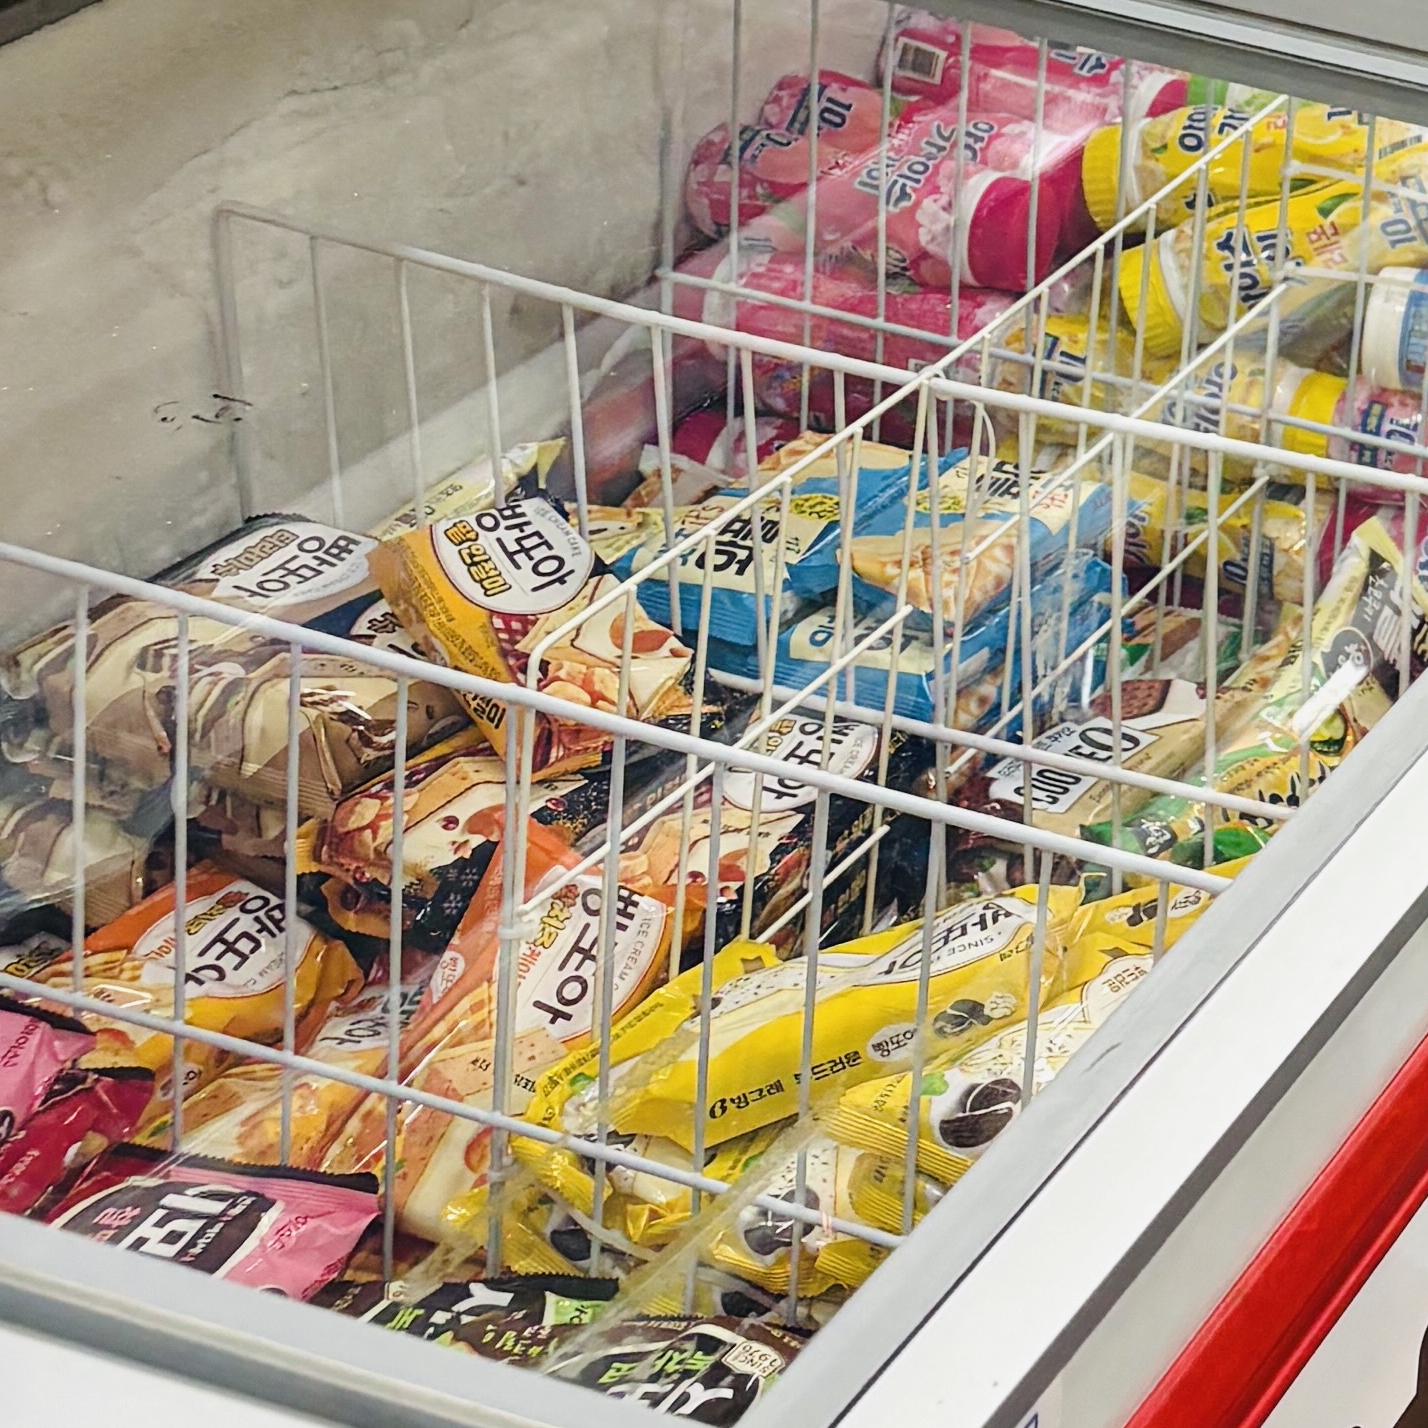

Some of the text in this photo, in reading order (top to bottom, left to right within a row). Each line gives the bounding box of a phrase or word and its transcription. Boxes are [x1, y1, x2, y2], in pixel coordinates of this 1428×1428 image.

[231, 531, 364, 603] 빵또아
[475, 499, 579, 597] 빵또아
[729, 1079, 786, 1111] 빙그레
